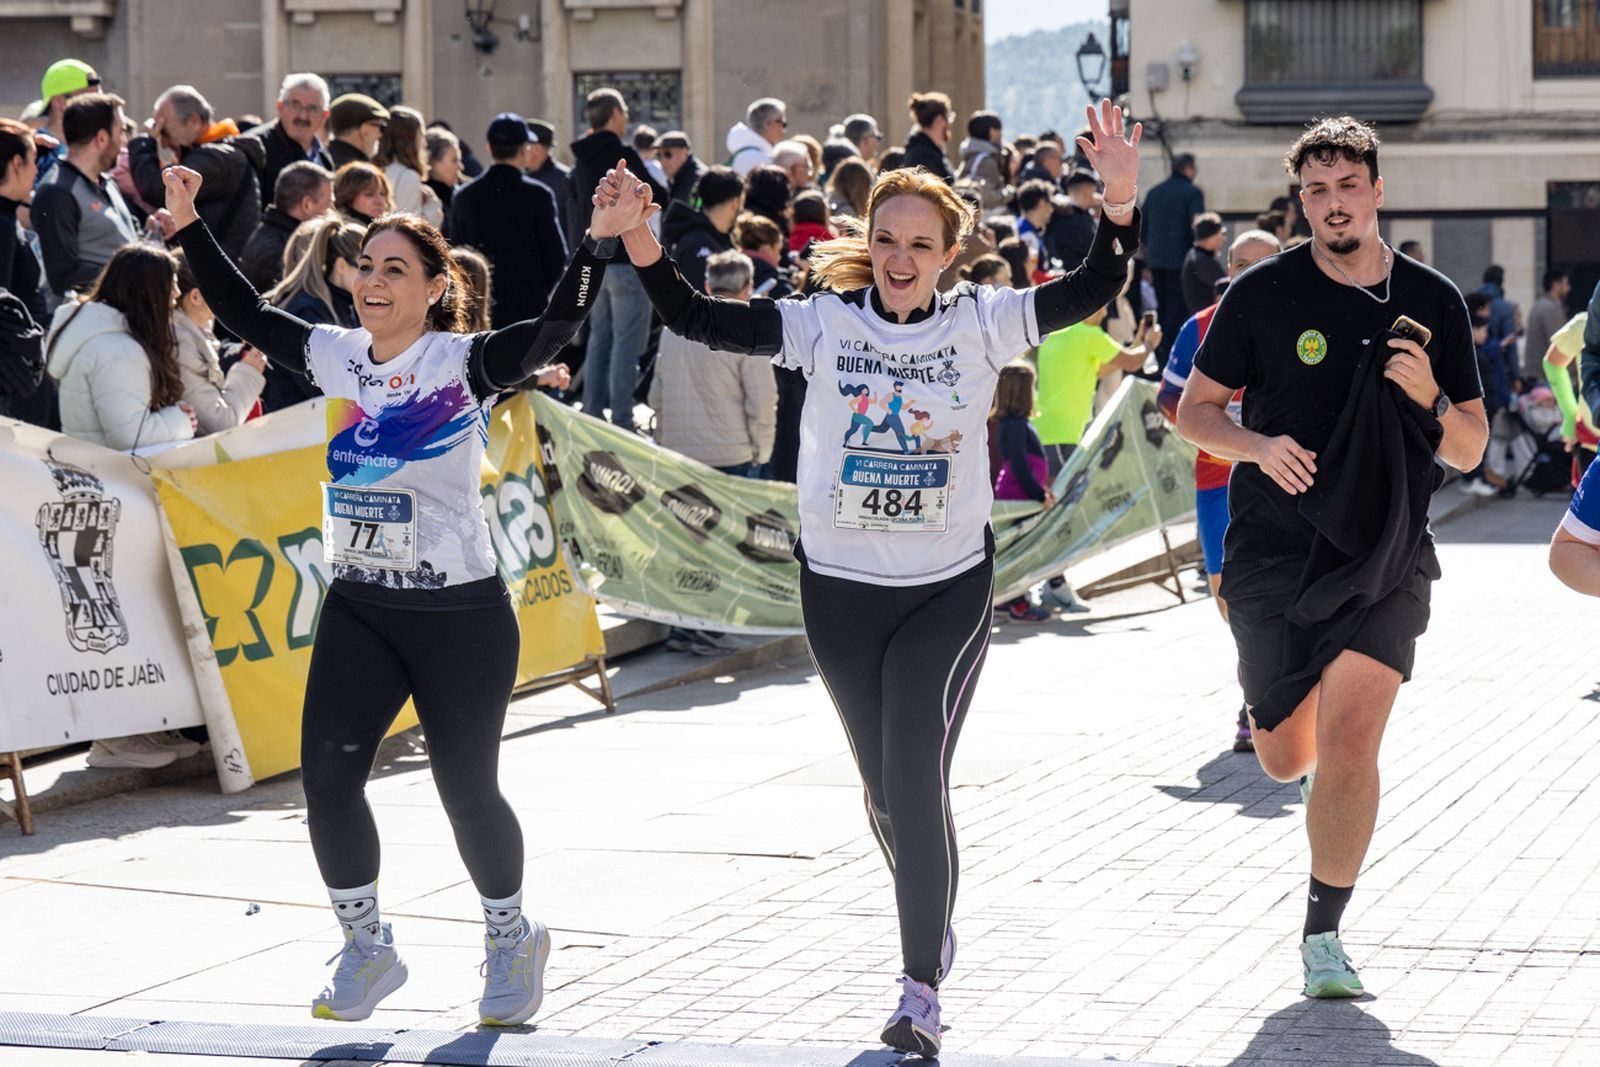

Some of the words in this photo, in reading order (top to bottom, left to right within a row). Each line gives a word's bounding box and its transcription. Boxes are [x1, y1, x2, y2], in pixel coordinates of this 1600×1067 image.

[576, 265, 592, 307] KIPRUN
[840, 339, 851, 350] VI
[900, 345, 957, 365] CAMINATA
[837, 355, 882, 375] BUENA
[333, 449, 398, 469] entrénate
[855, 459, 862, 467] VI
[863, 460, 898, 470] CARRERA
[900, 462, 937, 471] CAMINATA
[852, 471, 881, 484] BUENA
[884, 473, 920, 486] MUERTE
[364, 495, 401, 505] CAMINATA
[862, 489, 922, 517] 484
[334, 502, 354, 516] BUENA
[355, 506, 384, 519] MUERTE
[350, 521, 380, 550] 77
[46, 670, 100, 696] CIUDAD
[104, 667, 124, 689] DE
[128, 657, 166, 687] JAÉN
